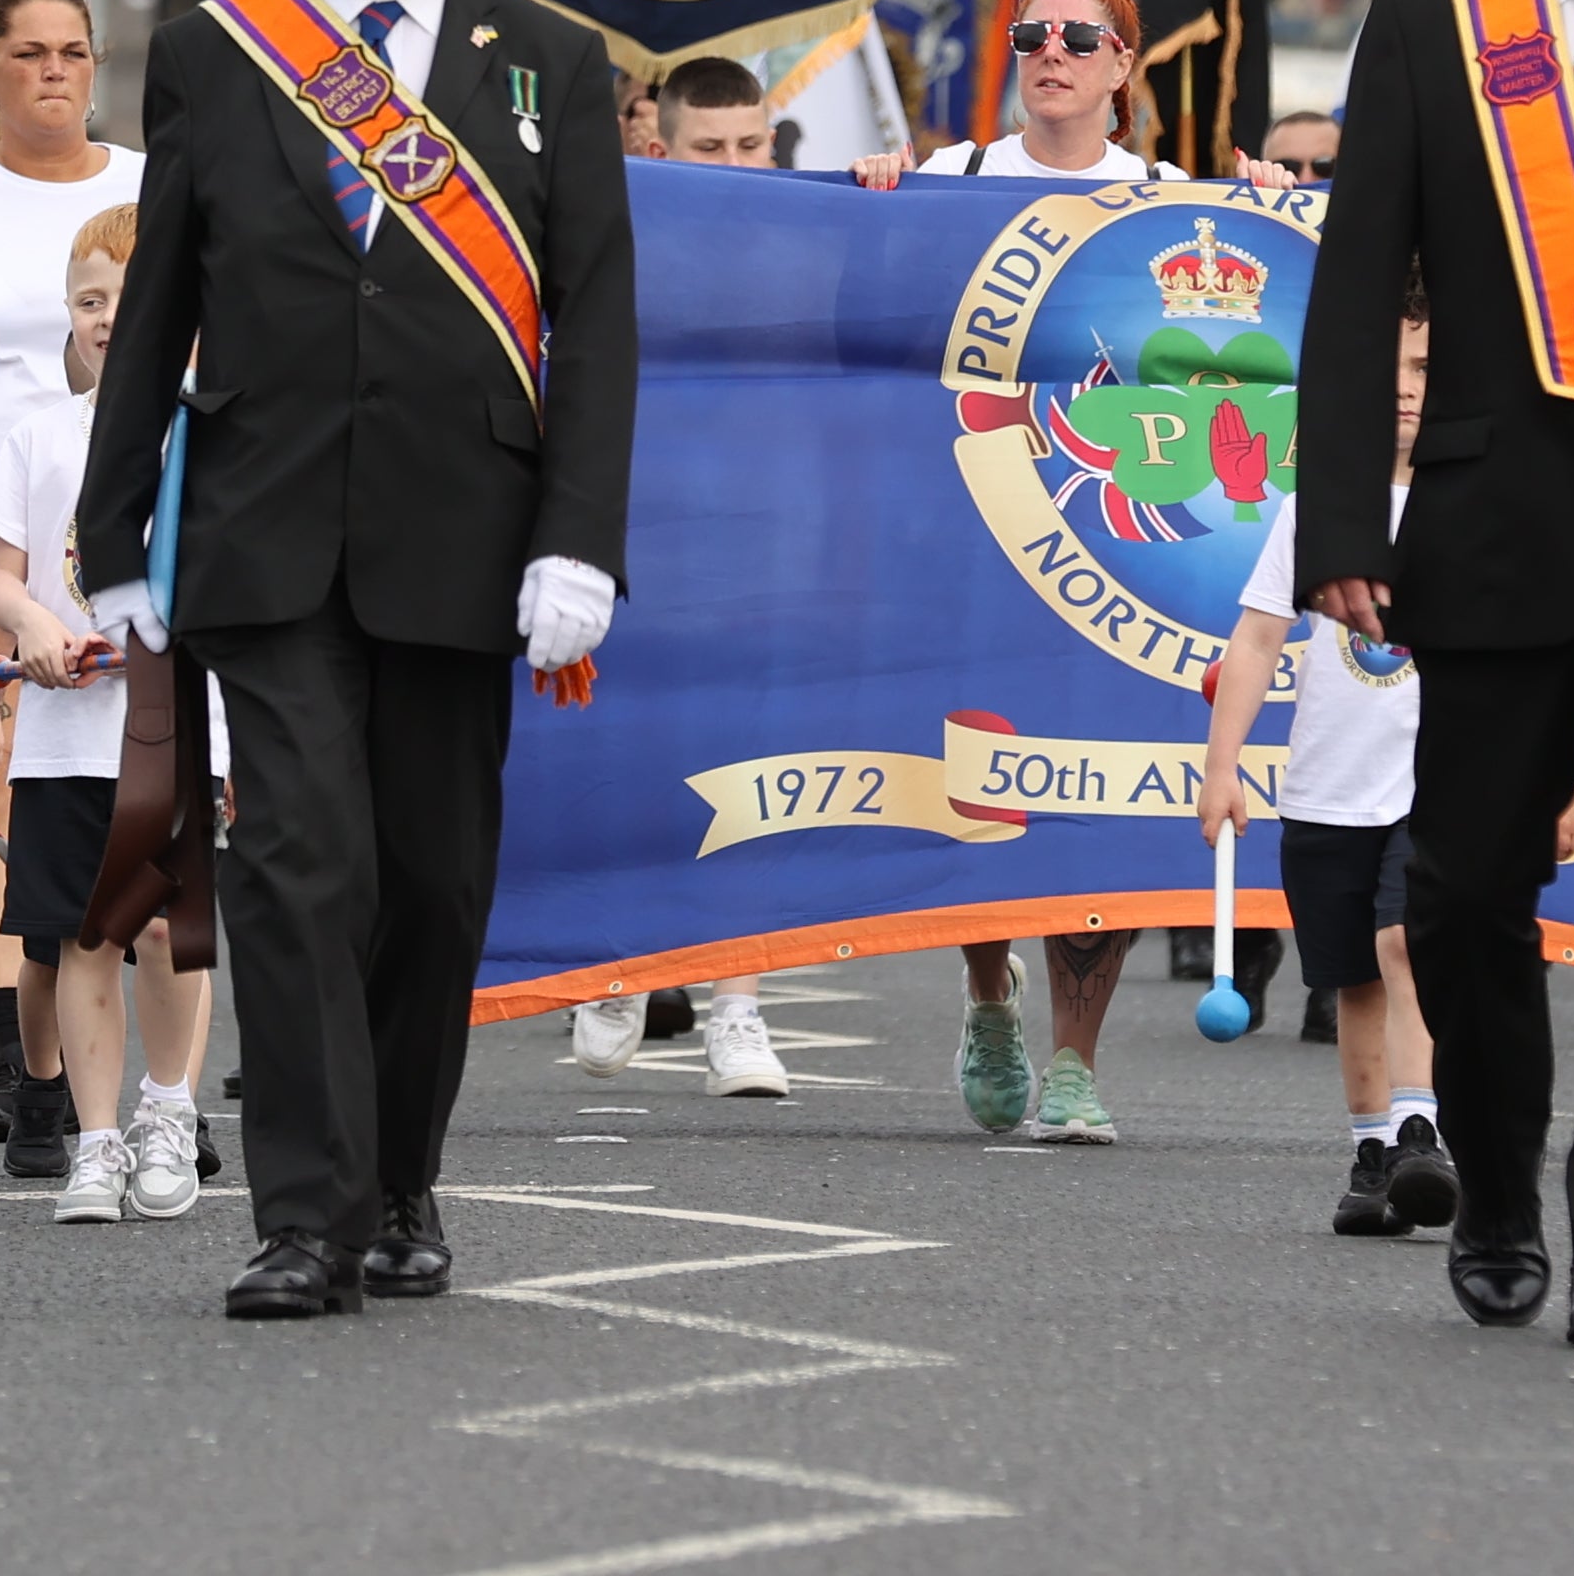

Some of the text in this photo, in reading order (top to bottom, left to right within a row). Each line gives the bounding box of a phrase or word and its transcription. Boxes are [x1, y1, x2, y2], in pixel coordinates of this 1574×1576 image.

[322, 68, 370, 110] DISTRICT
[334, 79, 382, 120] BELFAST
[957, 216, 1071, 382] PRIDE
[1130, 412, 1187, 466] P
[1022, 529, 1224, 676] NORTH
[1341, 646, 1371, 686] NORTH
[751, 765, 885, 822] 1972
[979, 749, 1106, 802] 50th
